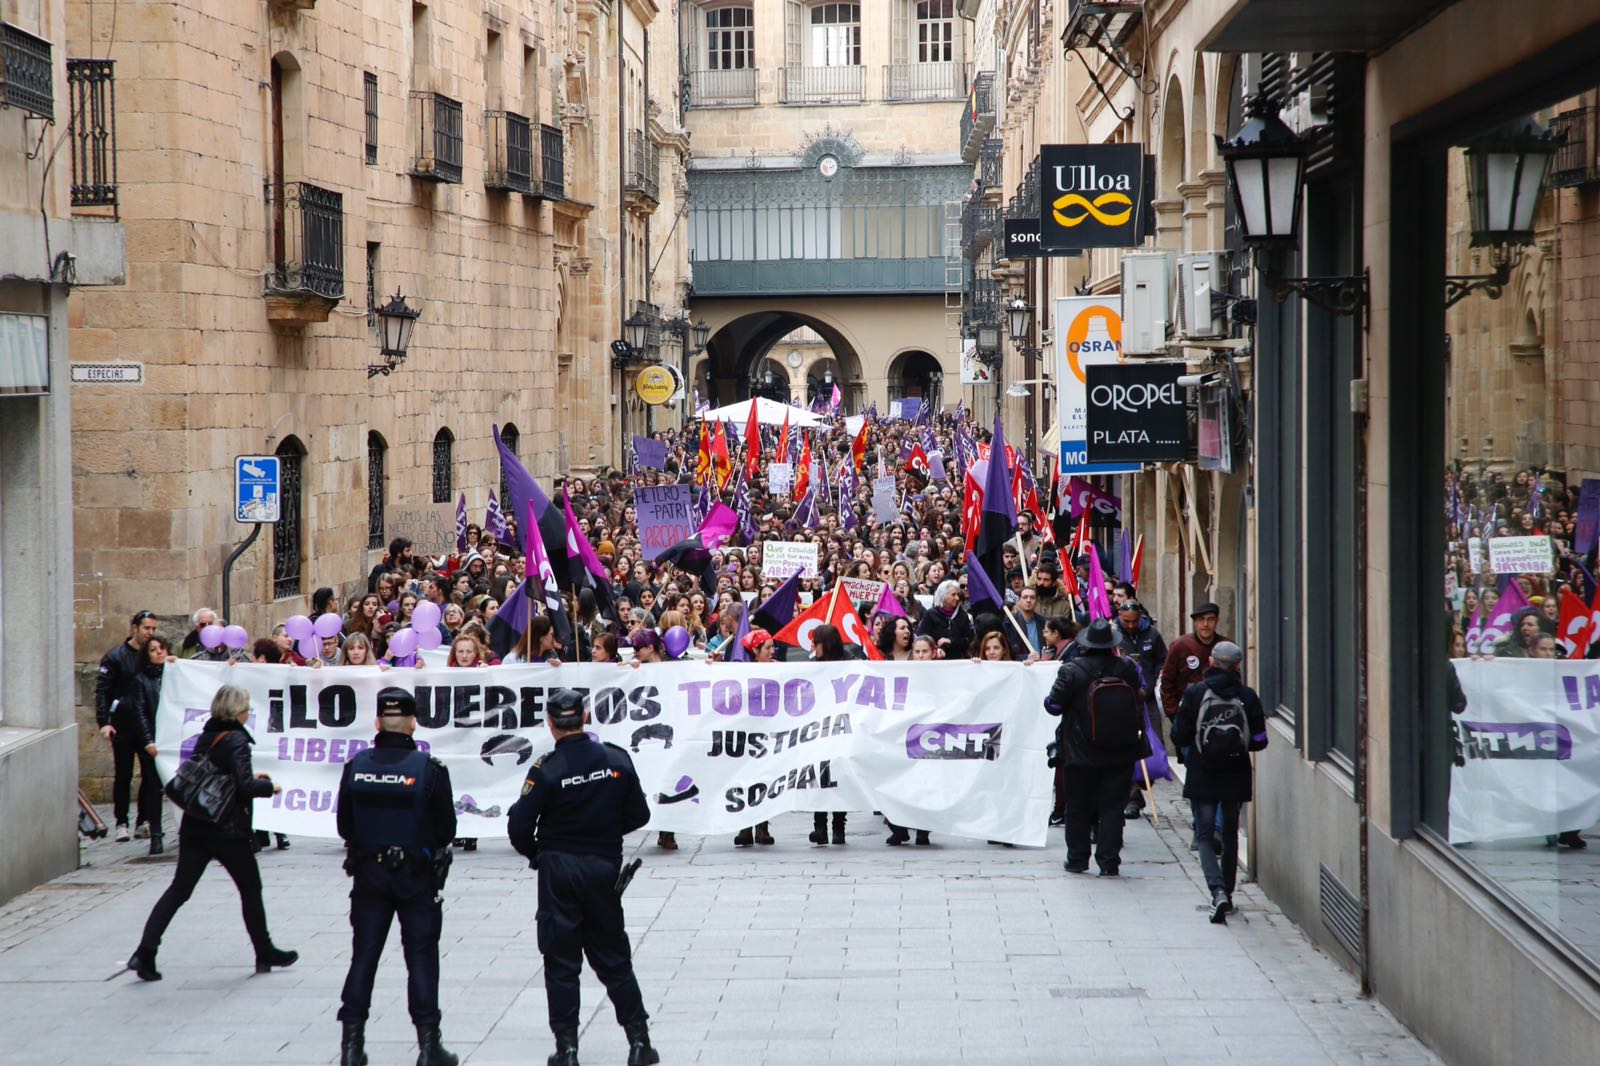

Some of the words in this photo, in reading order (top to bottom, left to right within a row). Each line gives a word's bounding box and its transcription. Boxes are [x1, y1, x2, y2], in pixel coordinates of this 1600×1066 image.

[1053, 165, 1132, 191] Ulloa
[87, 369, 124, 379] ESPECIAS
[1091, 383, 1183, 413] OROPEL
[1094, 430, 1151, 444] PLATA
[414, 685, 662, 730] UEREOS
[678, 678, 816, 717] TODO
[831, 673, 909, 711] YA!
[707, 713, 853, 759] JUSTICIA
[919, 730, 991, 753] CNT
[354, 773, 406, 785] POLICIA
[561, 768, 614, 789] POLICIA
[725, 760, 838, 813] SOCIAL
